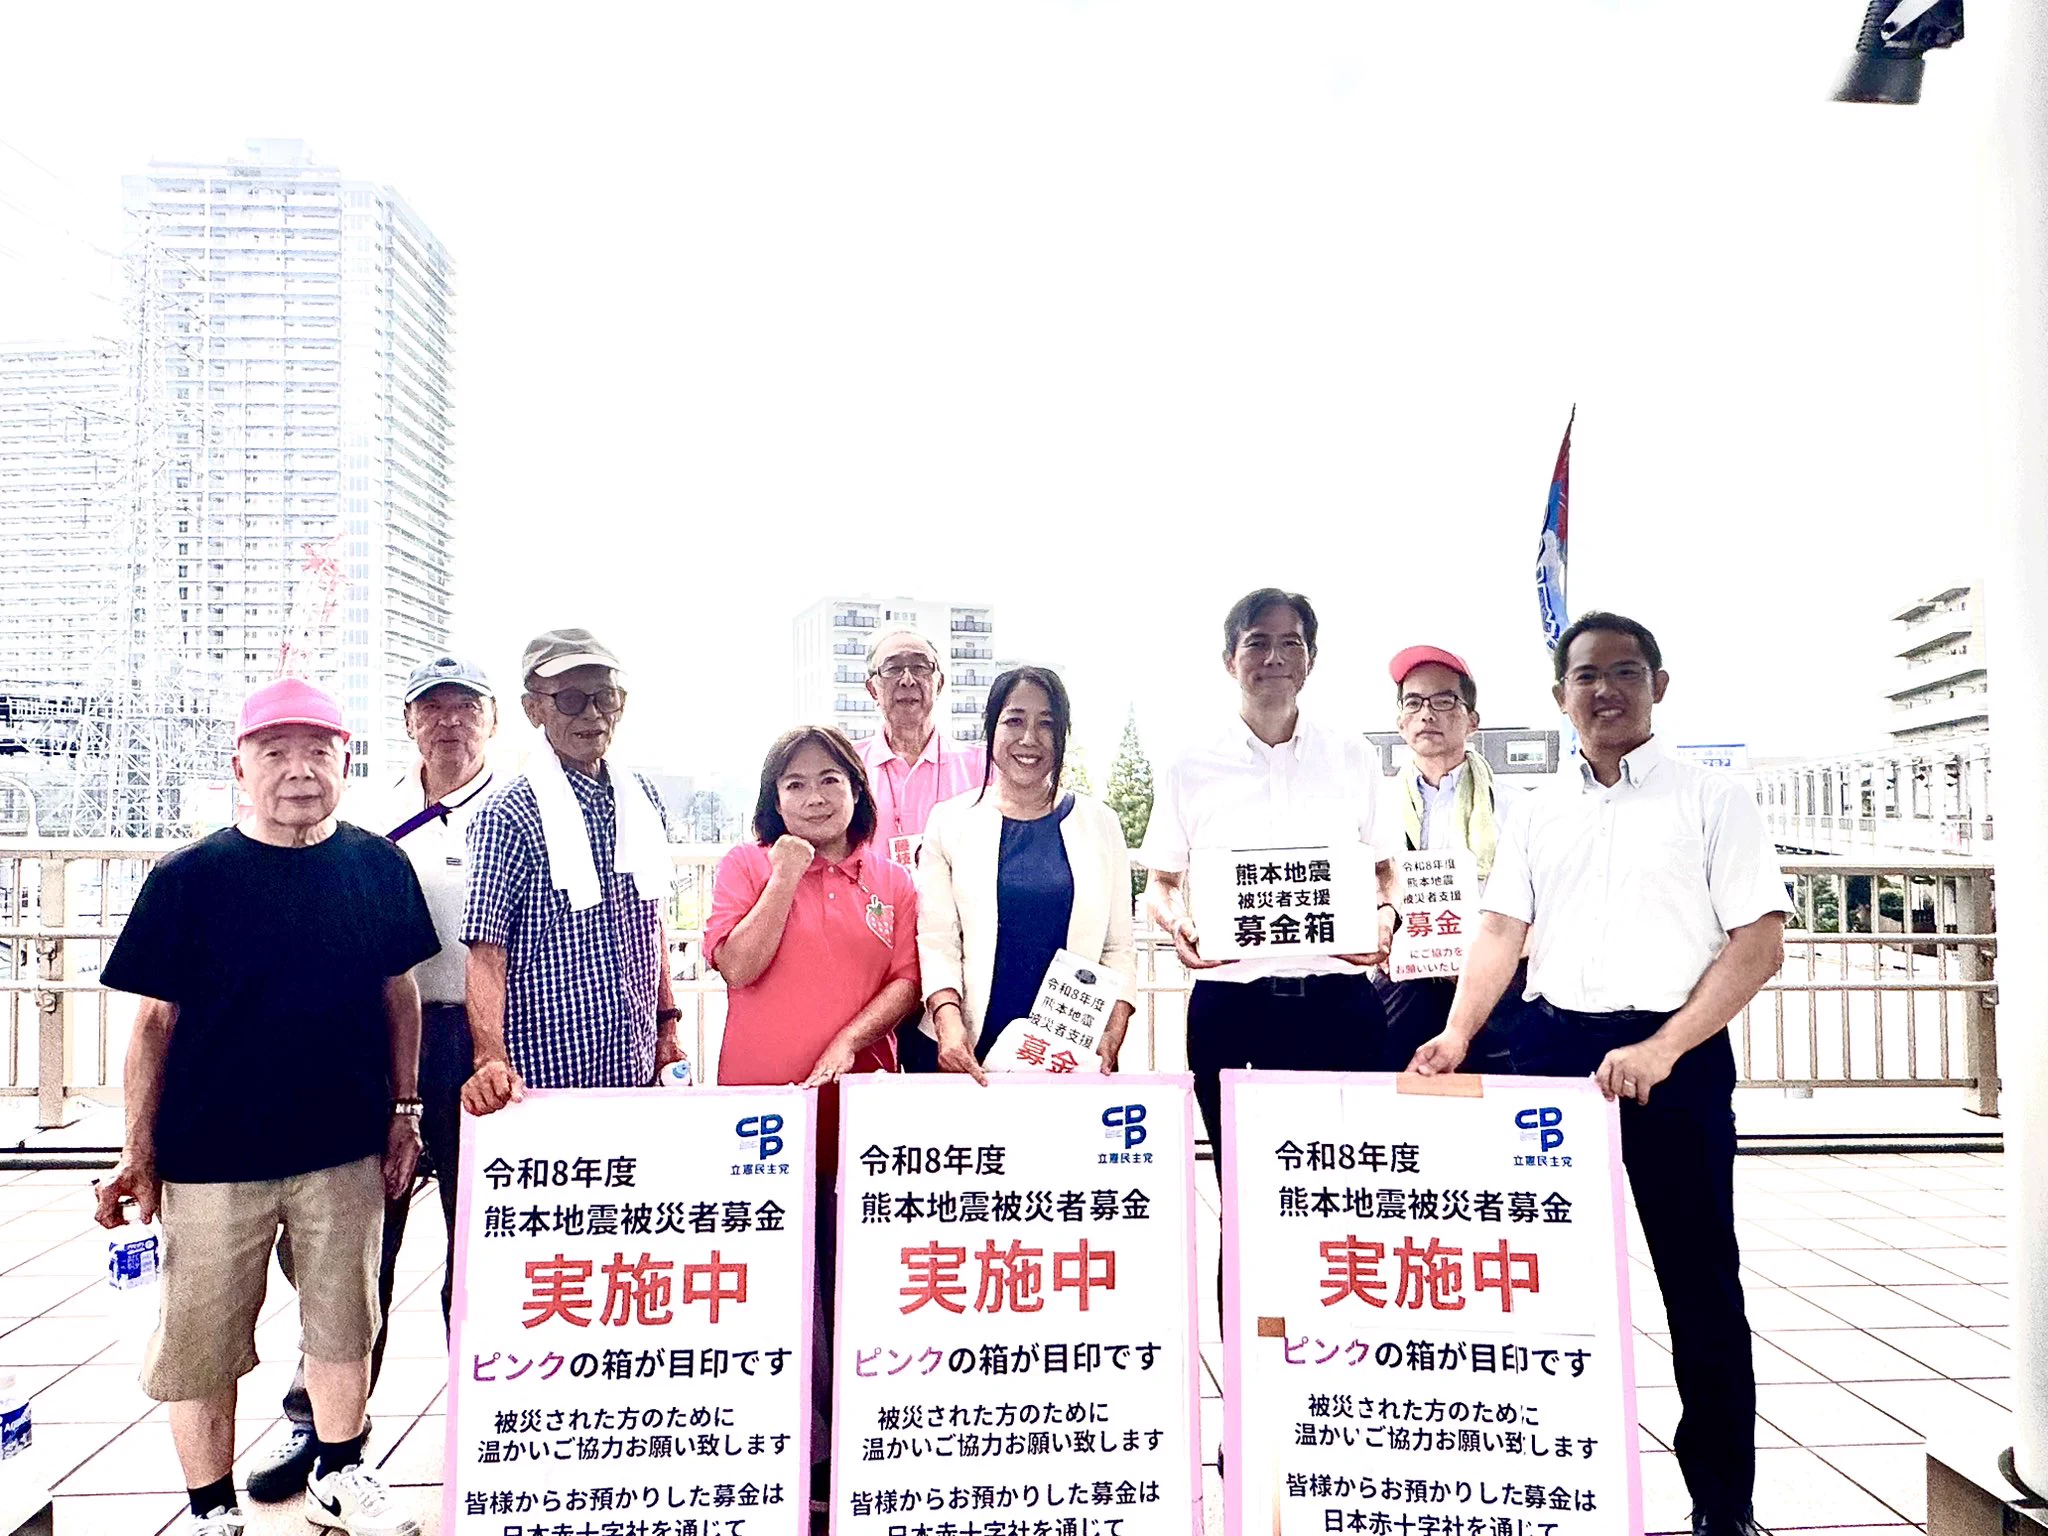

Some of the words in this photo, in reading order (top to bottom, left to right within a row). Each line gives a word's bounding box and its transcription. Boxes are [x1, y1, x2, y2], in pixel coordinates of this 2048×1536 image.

[1236, 860, 1331, 885] 熊本地震
[1403, 859, 1456, 872] 令和8年度
[1407, 875, 1454, 888] 熊本地震
[1238, 889, 1330, 909] 被災者支援
[1403, 890, 1462, 904] 被災者支援
[1234, 911, 1334, 947] 募金箱
[1406, 909, 1462, 937] 募金
[1048, 977, 1105, 1012] 令和8年度
[1041, 996, 1095, 1028] 熊本地震
[1029, 1012, 1094, 1050] 被災者支援
[1015, 1033, 1079, 1074] 募金
[730, 1163, 790, 1176] 立憲民主党
[859, 1144, 1006, 1176] 令和8年度
[1097, 1153, 1153, 1164] 立憲民主党
[1275, 1140, 1421, 1173] 令和8年度
[1513, 1155, 1572, 1167] 立憲民主党
[483, 1156, 637, 1190] 令和8年度
[484, 1200, 786, 1237] 熊本地震被災者募金
[861, 1189, 1151, 1223] 熊本地震被災者募金
[1279, 1186, 1573, 1223] 熊本地震被災者募金
[522, 1250, 748, 1329] 実施中
[900, 1239, 1116, 1314] 実施中
[1319, 1235, 1540, 1312] 実施中
[474, 1348, 793, 1381] ピンクの箱が目印です
[856, 1342, 1162, 1377] ピンクの箱が目印です
[1284, 1336, 1592, 1377] ピンクの箱が目印です
[494, 1406, 735, 1434] 被災された方のために
[877, 1402, 1109, 1430] 被災された方のために
[1308, 1394, 1539, 1425] 被災された方のために
[477, 1433, 791, 1463] 温かいご協力お願い致します
[862, 1429, 1164, 1461] 温かいご協力お願い致します
[1295, 1423, 1599, 1459] 温かいご協力お願い致します
[464, 1483, 785, 1515] 皆様からお預かりした募金は
[850, 1480, 1160, 1516] 皆様からお預かりした募金は
[1286, 1473, 1597, 1511] 皆様からお預かりした募金は
[1325, 1509, 1559, 1536] 日本赤十字社を通じて
